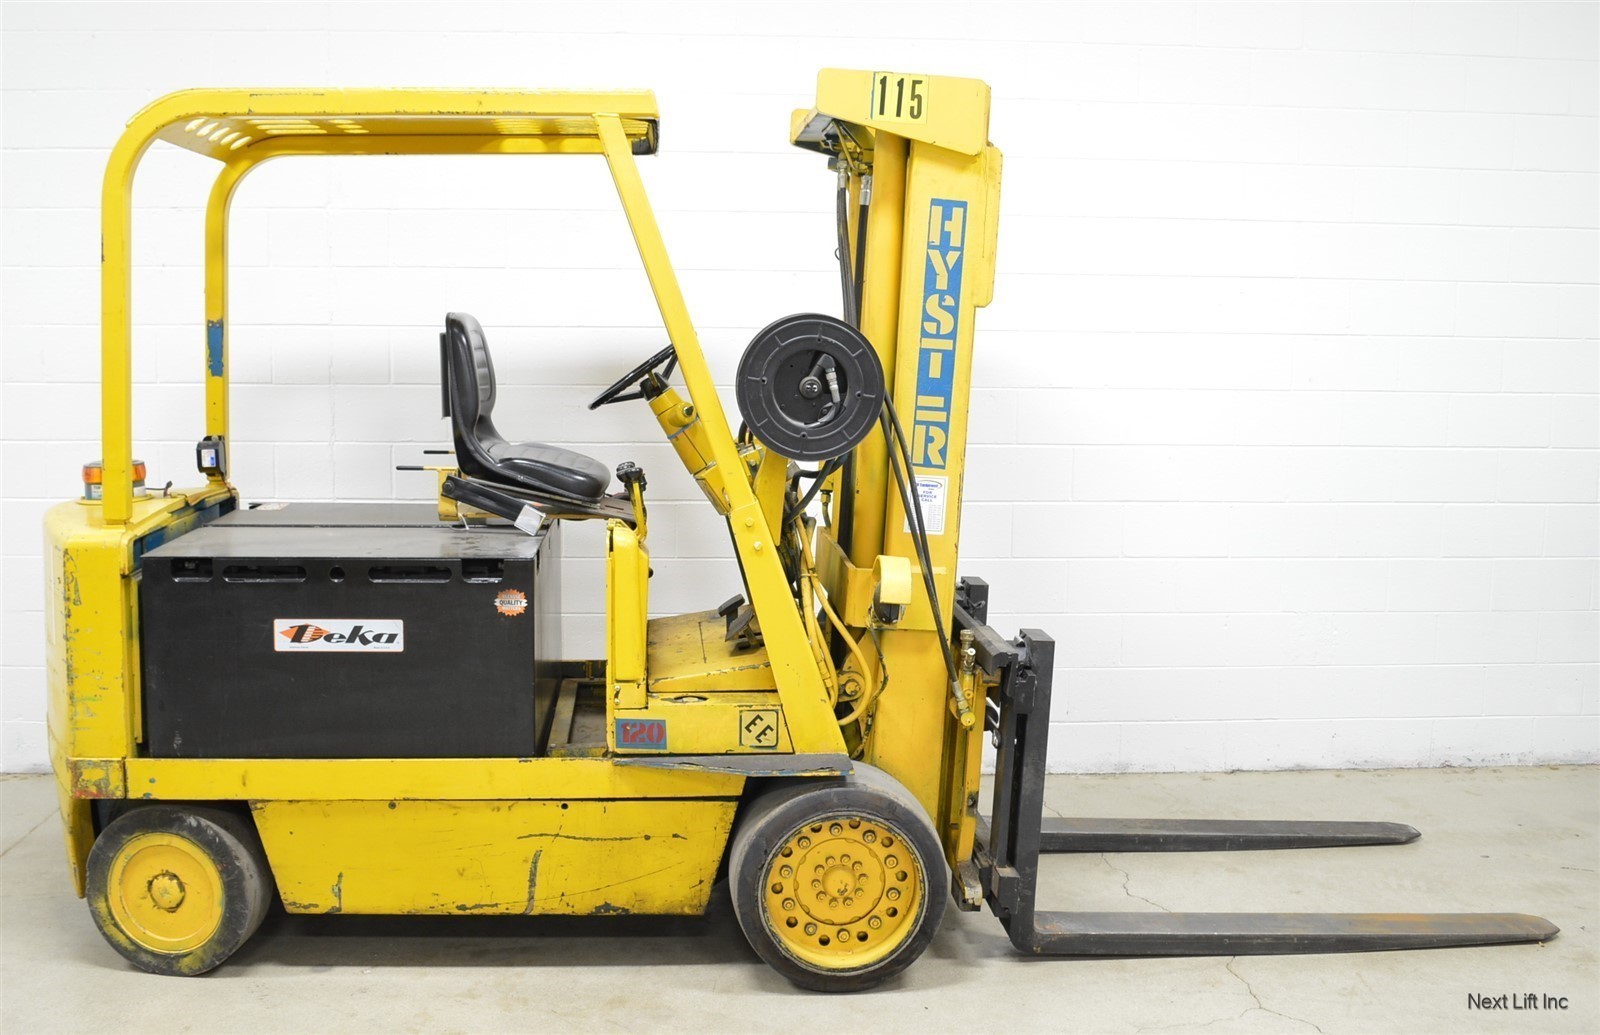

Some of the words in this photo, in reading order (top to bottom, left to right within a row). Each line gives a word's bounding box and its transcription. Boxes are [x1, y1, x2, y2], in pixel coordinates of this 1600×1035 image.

[879, 75, 923, 119] 115
[911, 205, 964, 466] HYSTER
[289, 624, 399, 646] Deka
[621, 722, 665, 744] 120
